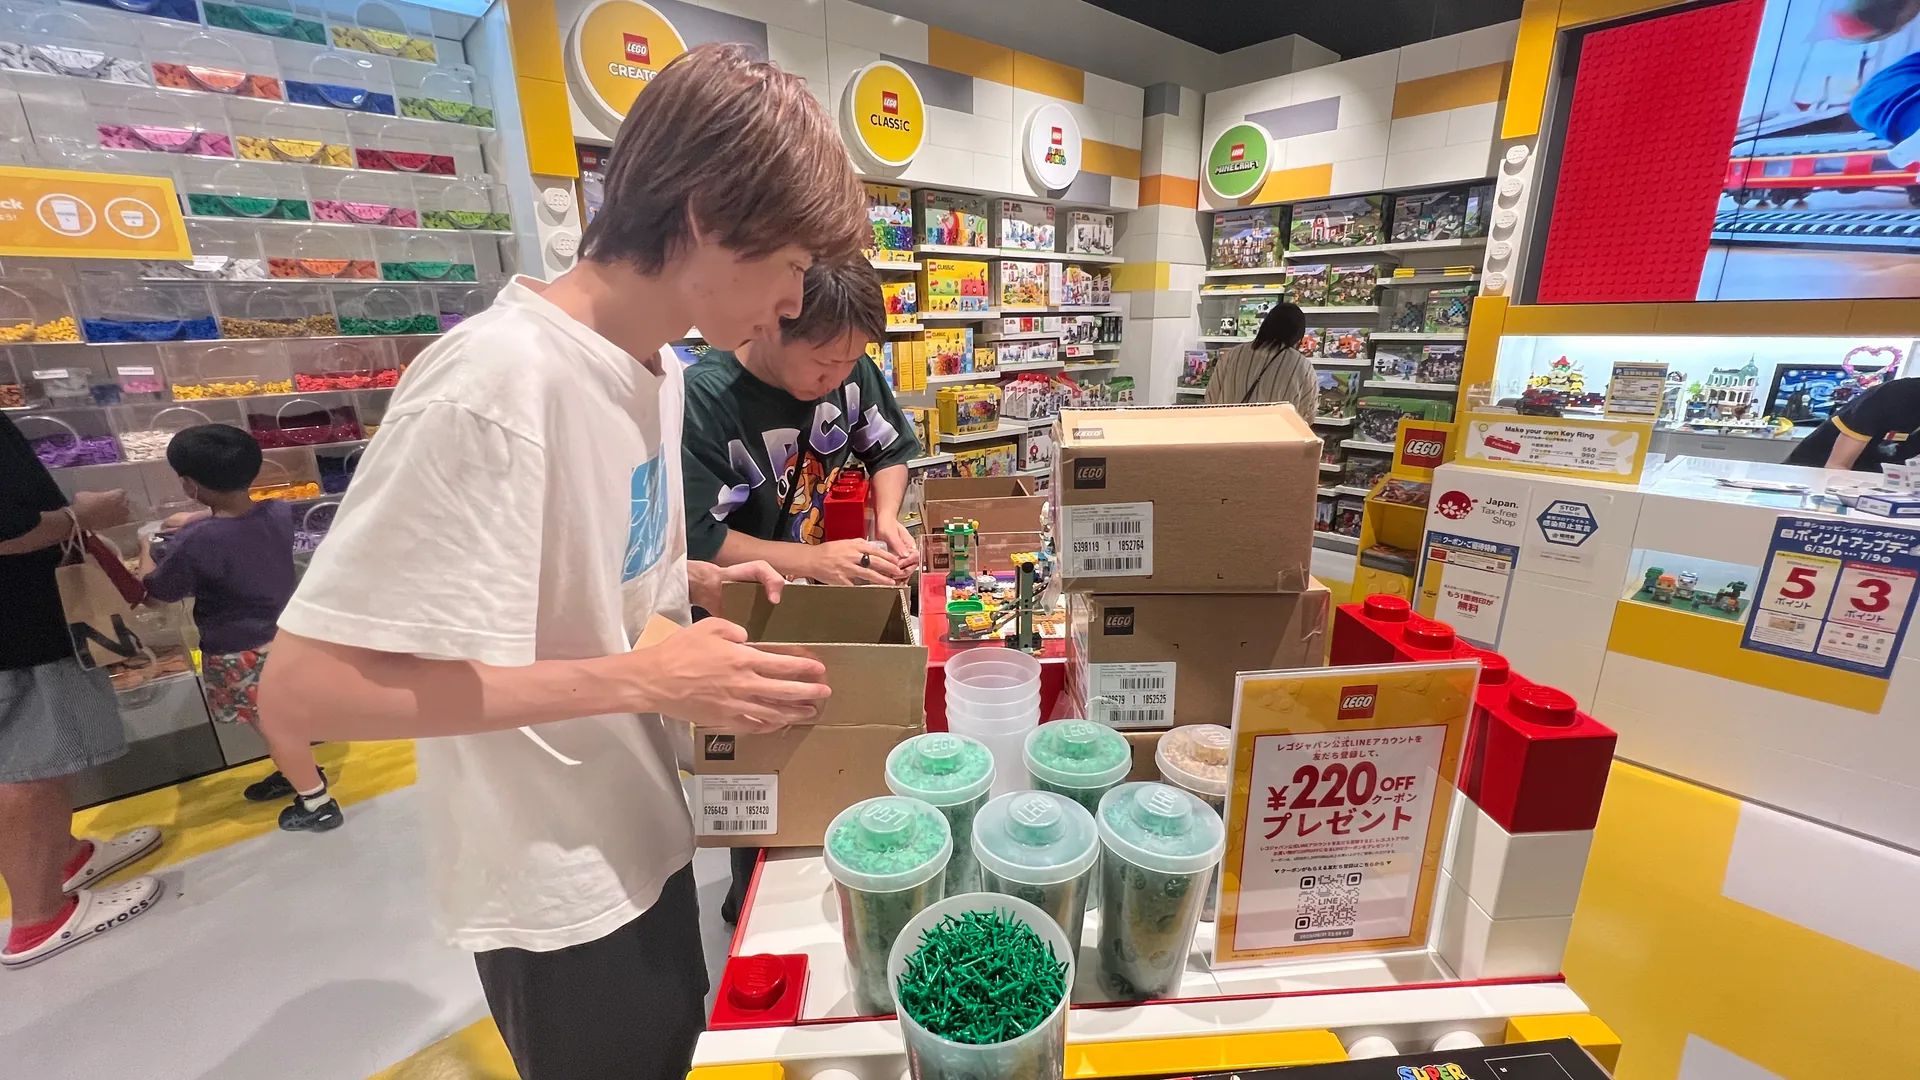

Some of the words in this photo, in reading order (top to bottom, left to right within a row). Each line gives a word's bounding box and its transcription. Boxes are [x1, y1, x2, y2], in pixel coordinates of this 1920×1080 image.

[627, 42, 647, 56] LEGO
[608, 62, 657, 82] CREATO
[884, 97, 897, 108] LEGO
[870, 114, 910, 132] CLASSIC
[1214, 160, 1259, 175] MINECRAFT
[1504, 425, 1524, 434] Make
[1525, 428, 1542, 436] your
[1560, 430, 1575, 439] Key
[1576, 431, 1595, 440] Ring
[1404, 440, 1443, 458] LEGO
[1077, 466, 1104, 480] LEGO
[1485, 497, 1519, 509] Japan.
[1559, 504, 1581, 512] STOP
[1480, 506, 1518, 519] Tax-free
[1491, 516, 1516, 528] Shop
[1073, 541, 1100, 553] 6398119
[1118, 539, 1144, 551] 1852764
[1779, 566, 1818, 600] 5
[1850, 578, 1892, 613] 3
[1456, 600, 1479, 615] 無料
[1775, 597, 1812, 610] ポイント
[1106, 615, 1131, 627] LEGO
[1844, 609, 1885, 622] ポイント
[1341, 693, 1375, 710] LEGO
[709, 742, 732, 753] LEGO
[924, 736, 958, 753] LEGO
[1277, 736, 1423, 752] レゴジャパン公式LINEアカウントを
[1267, 761, 1378, 811] ¥220
[1379, 775, 1416, 792] OFF
[1371, 793, 1417, 805] クーポン
[865, 803, 909, 826] LEGO
[1016, 793, 1053, 823] LEGO
[1263, 806, 1413, 840] プレゼント
[1318, 897, 1339, 906] LINE
[93, 899, 150, 934] crocs
